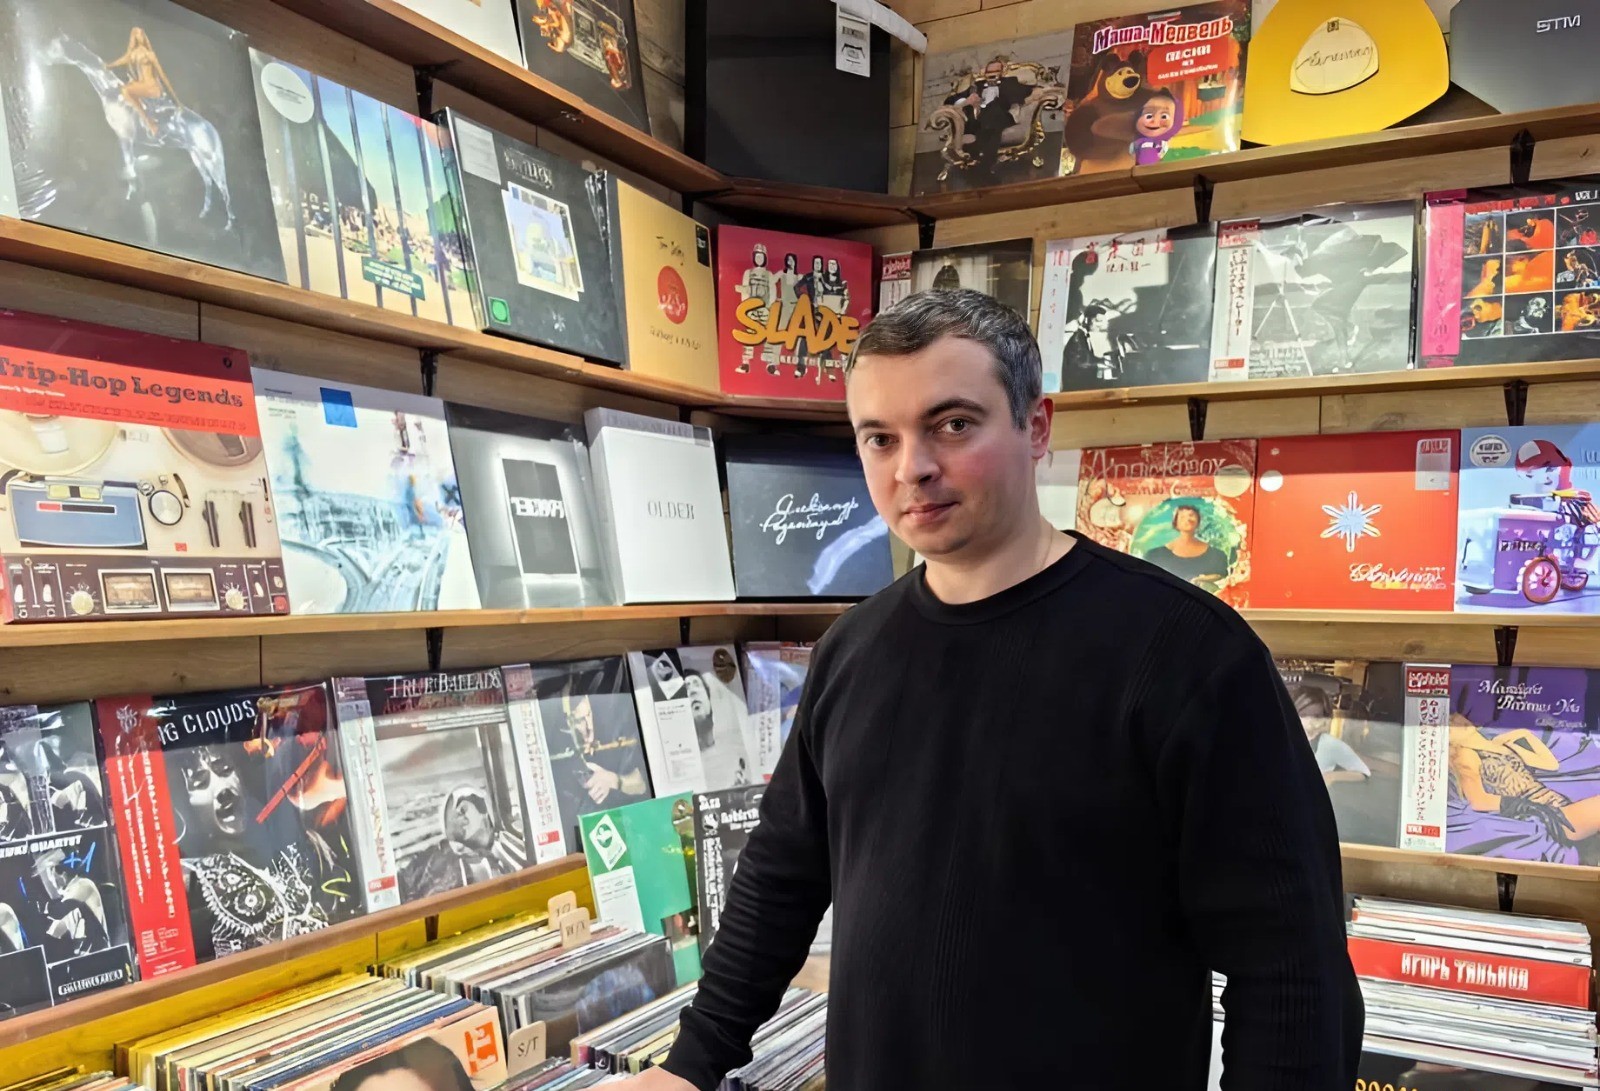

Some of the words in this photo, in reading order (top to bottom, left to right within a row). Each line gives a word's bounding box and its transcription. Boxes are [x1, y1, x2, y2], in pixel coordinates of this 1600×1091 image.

[1093, 26, 1144, 54] Маша
[732, 293, 860, 354] SLADE
[0, 357, 127, 397] Trip-Hop
[131, 375, 243, 407] Legends
[647, 500, 695, 519] OLDER
[183, 700, 256, 734] CLOUDS
[63, 842, 96, 873] +1
[517, 1036, 539, 1058] S/T
